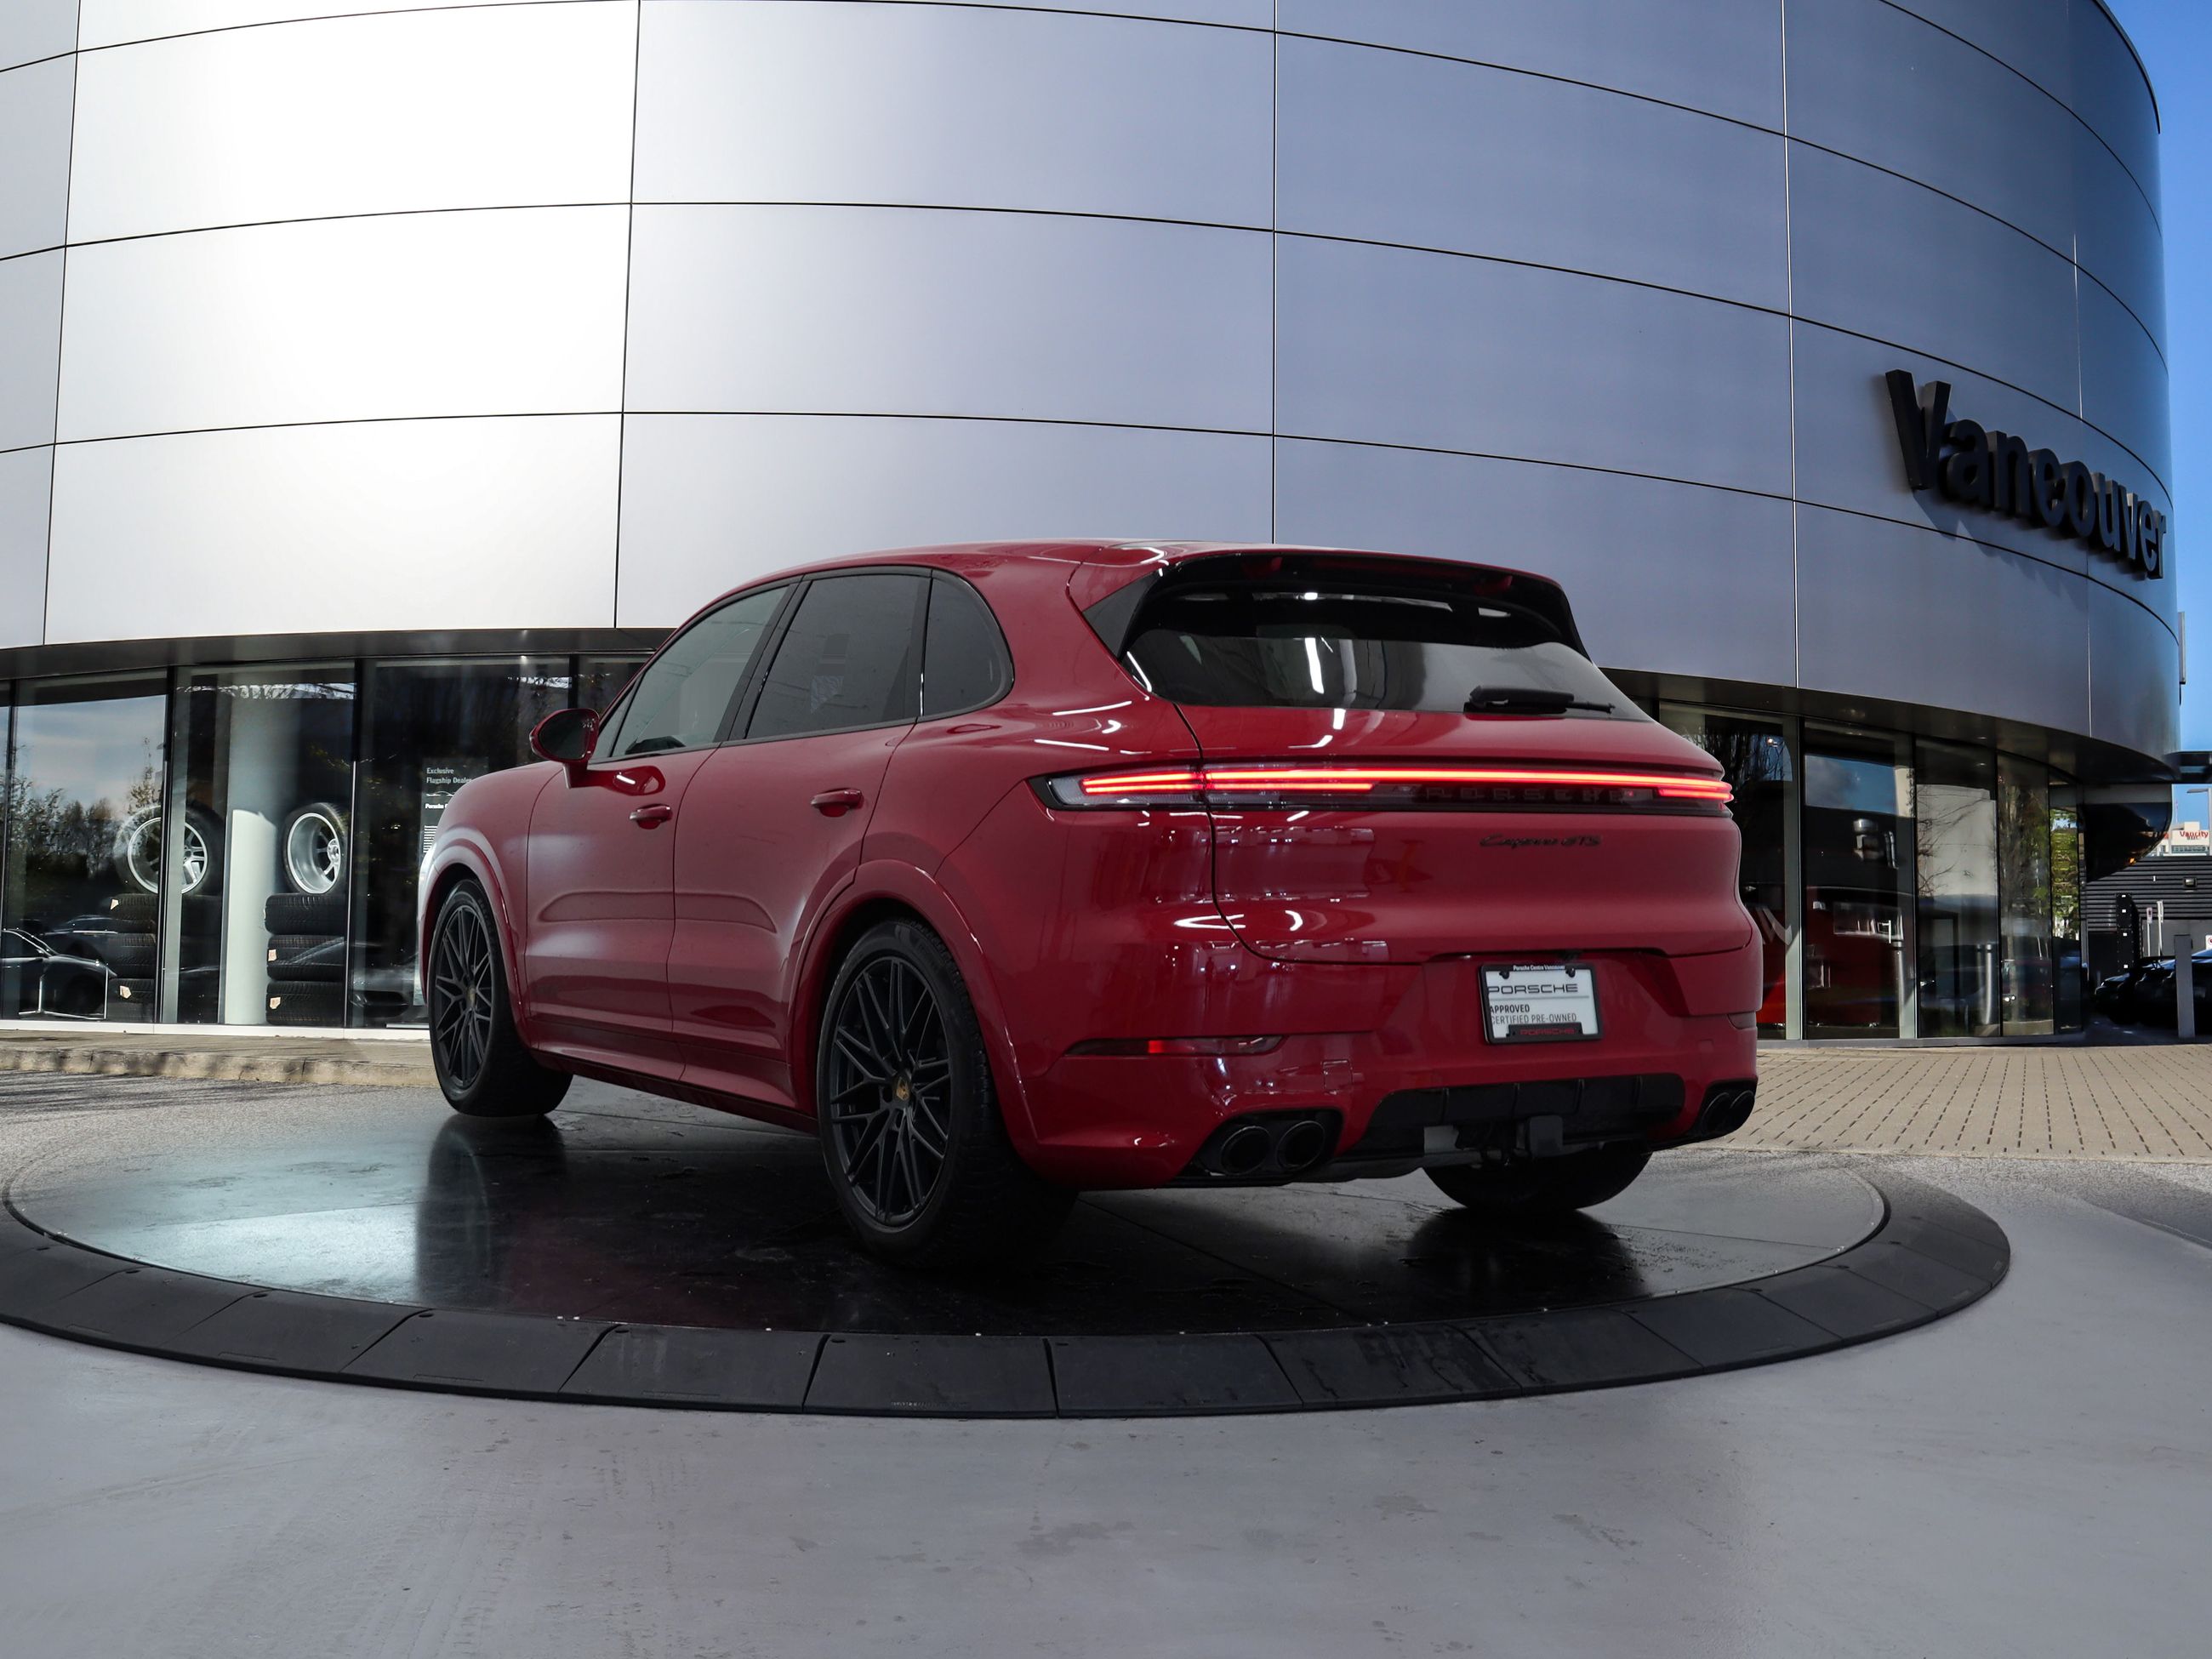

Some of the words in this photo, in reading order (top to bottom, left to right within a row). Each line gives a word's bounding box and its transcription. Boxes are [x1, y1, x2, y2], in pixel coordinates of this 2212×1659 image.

[1885, 369, 2166, 579] Vancouver
[1488, 983, 1578, 995] PORSCHE
[1490, 1004, 1531, 1013] APPROVED
[1491, 1014, 1530, 1024] CERTIFIED
[1531, 1012, 1577, 1023] PRE-OWNED
